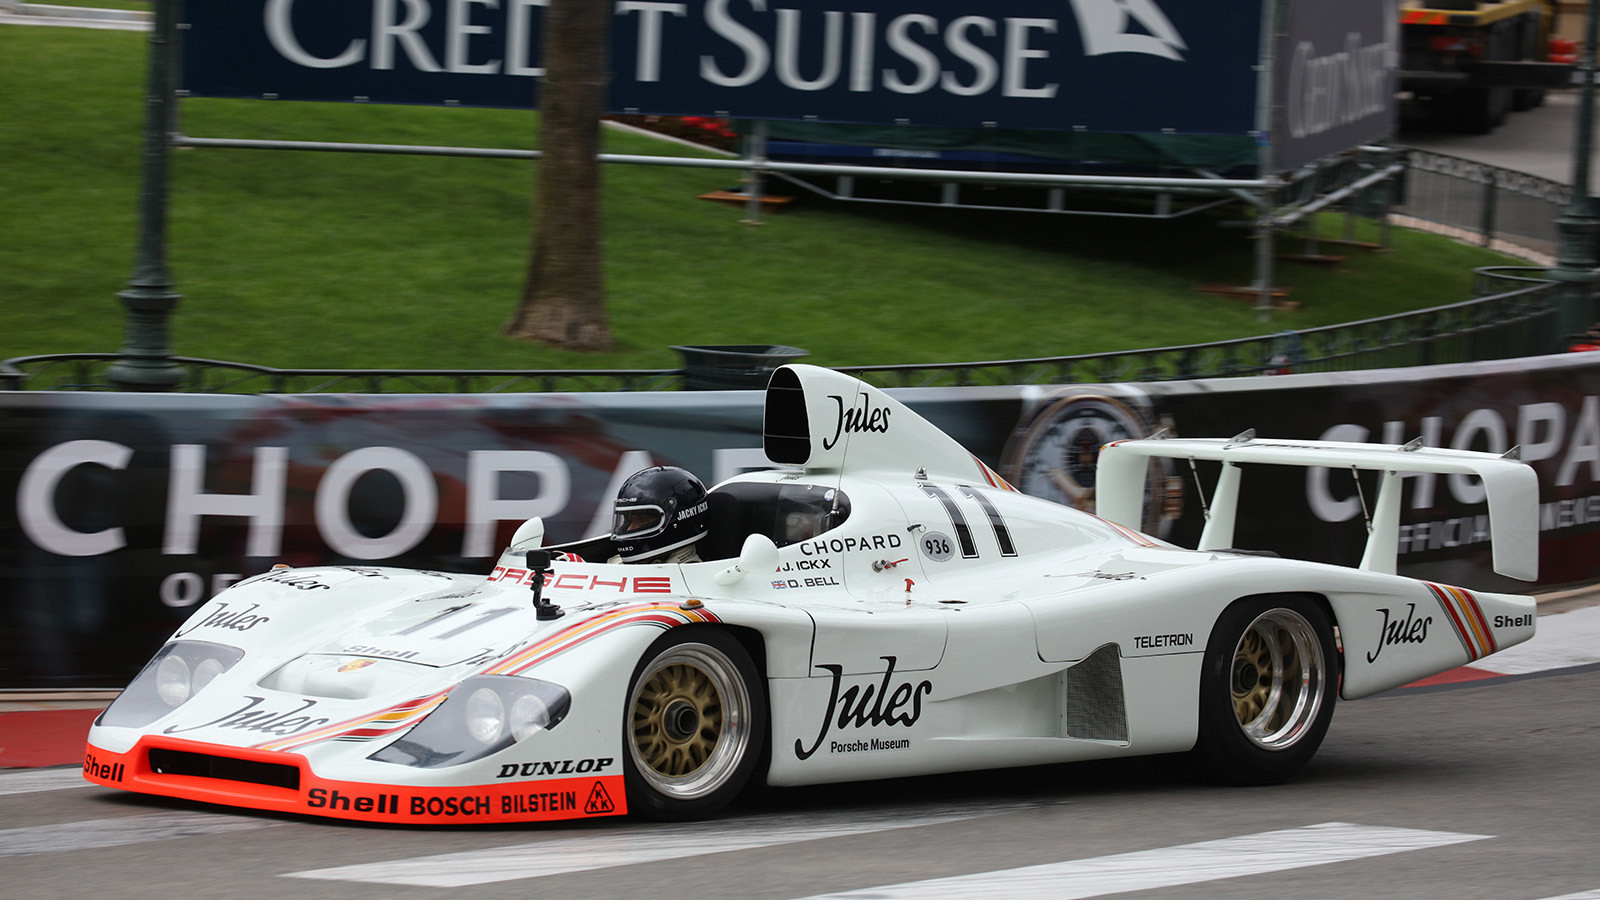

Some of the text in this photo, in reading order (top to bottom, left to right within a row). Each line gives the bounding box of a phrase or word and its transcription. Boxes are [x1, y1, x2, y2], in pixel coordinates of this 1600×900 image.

[263, 0, 1059, 98] CRET SUISSE
[823, 392, 891, 450] Jules
[16, 439, 767, 560] CHOPA
[677, 506, 698, 521] JACKY
[918, 483, 1018, 559] 11
[1397, 515, 1492, 554] FFICIA
[800, 534, 902, 556] CHOPARD
[925, 539, 950, 555] 936
[782, 558, 831, 572] J. ICKX
[787, 576, 839, 588] D. BELL
[175, 602, 270, 639] Jules
[1367, 602, 1433, 664] Jules
[1494, 614, 1533, 628] Shell
[343, 645, 420, 660] Shell
[1134, 633, 1194, 650] TELETRON
[163, 695, 330, 736] Jules
[794, 656, 932, 760] Jules
[831, 738, 910, 753] Porsche Museum
[84, 753, 125, 783] Shell
[496, 758, 614, 778] DUNLOP
[307, 788, 576, 816] Shell BOSCH BILSTEIN
